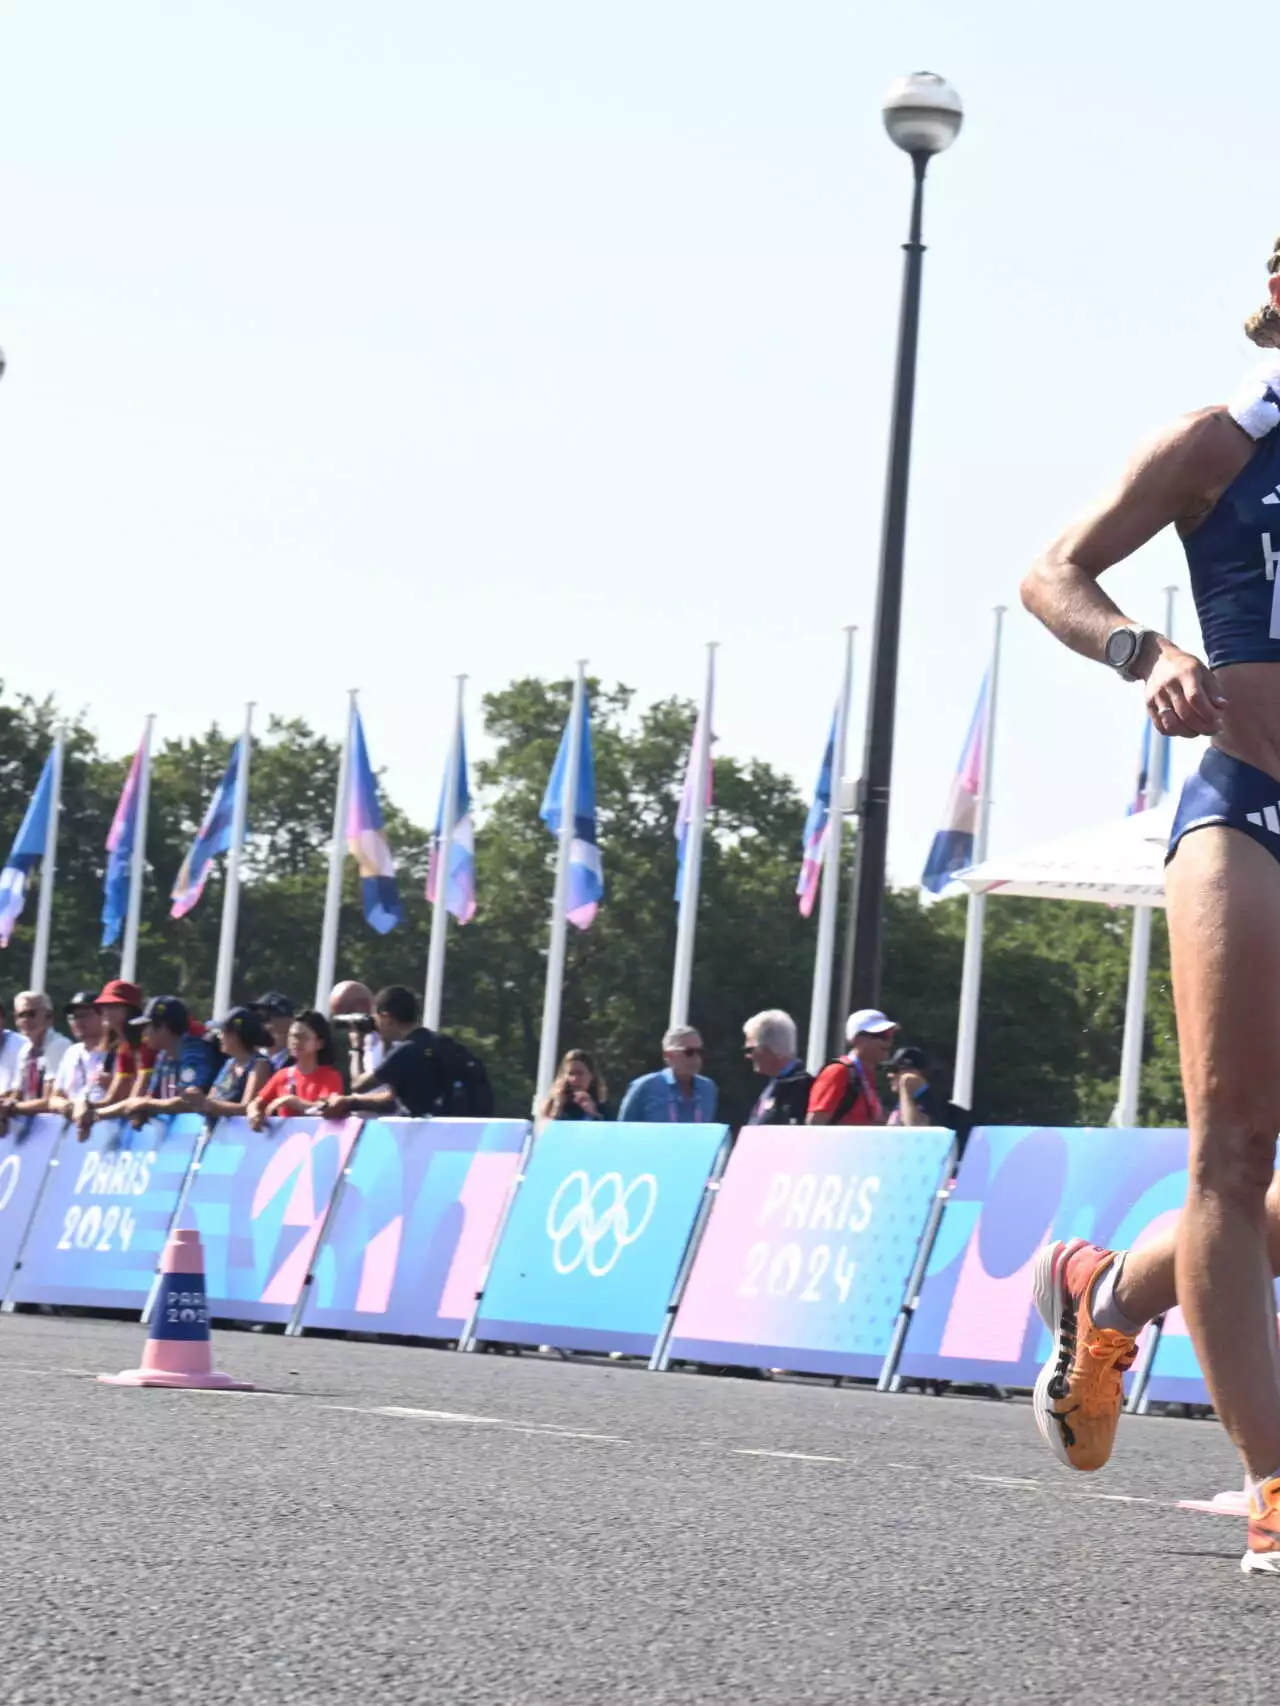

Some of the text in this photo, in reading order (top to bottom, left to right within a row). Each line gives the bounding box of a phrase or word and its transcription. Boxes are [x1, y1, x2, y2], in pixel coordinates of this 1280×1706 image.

[56, 1205, 136, 1252] 2024
[735, 1241, 857, 1304] 2024
[167, 1308, 208, 1323] 202
